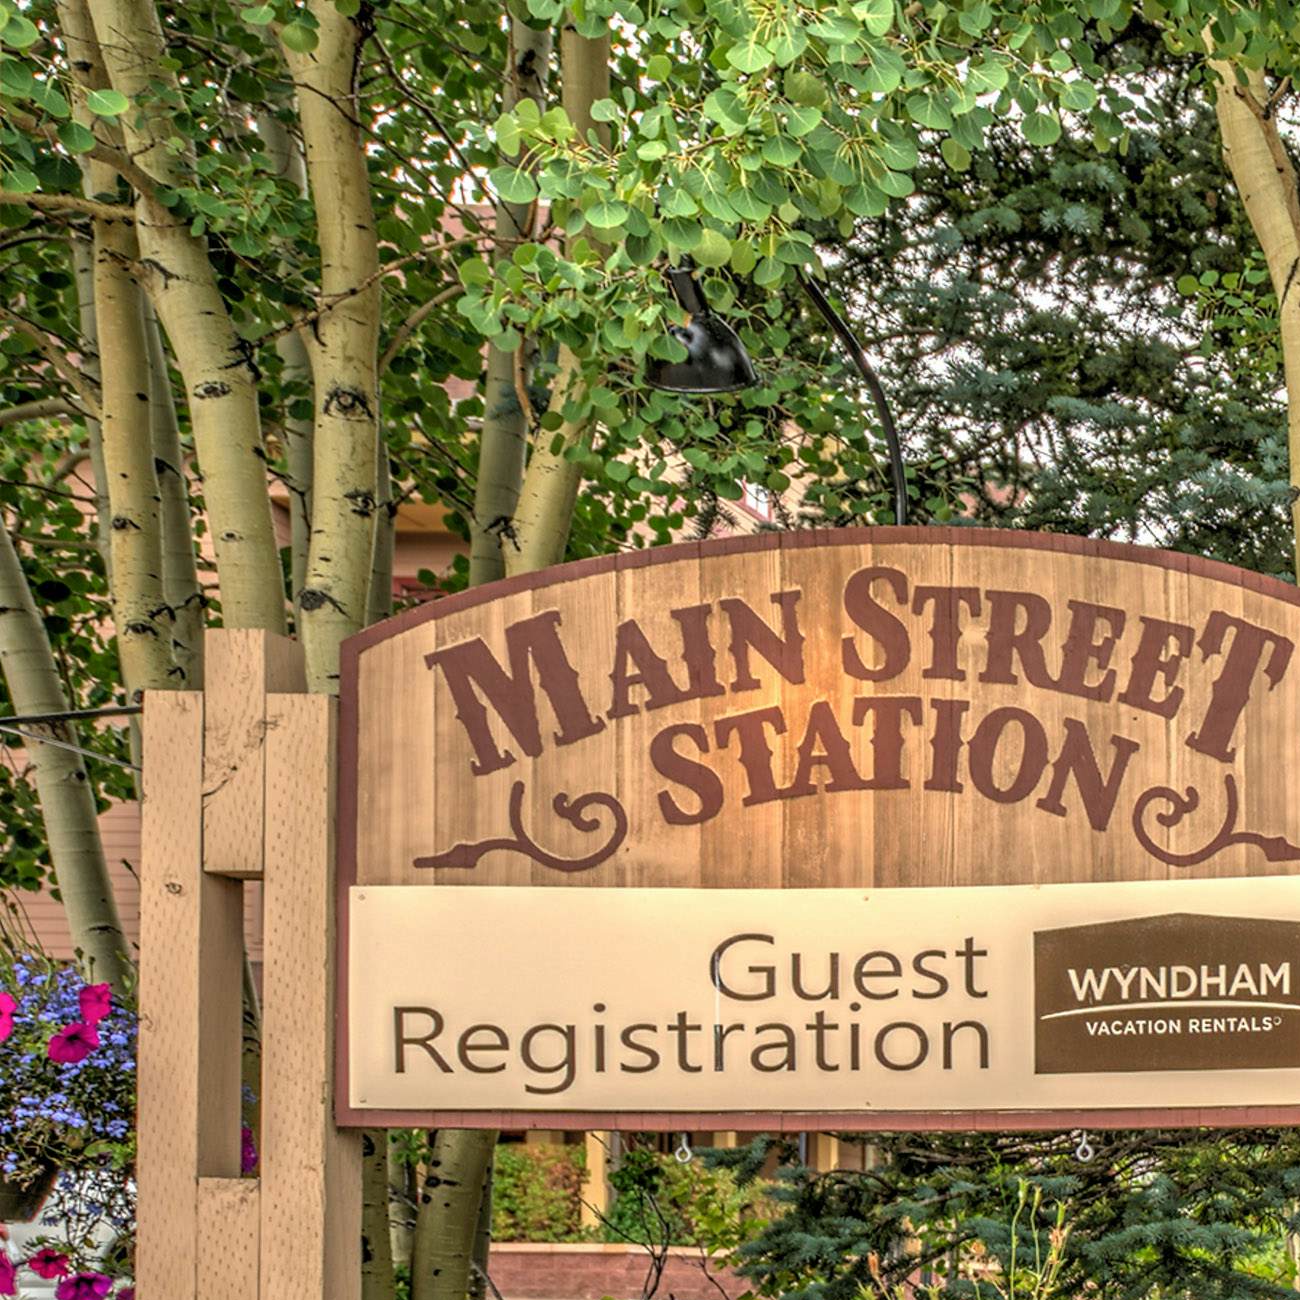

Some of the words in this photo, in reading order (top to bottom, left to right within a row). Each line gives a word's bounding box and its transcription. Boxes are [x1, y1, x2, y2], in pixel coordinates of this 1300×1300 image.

[424, 588, 803, 776] MAIN
[840, 566, 1295, 763] STREET
[650, 697, 1140, 832] STATION
[710, 933, 990, 1002] Guest
[1067, 962, 1291, 1001] WYNDHAM
[393, 1002, 991, 1096] Registration
[1086, 1019, 1182, 1036] VACATION
